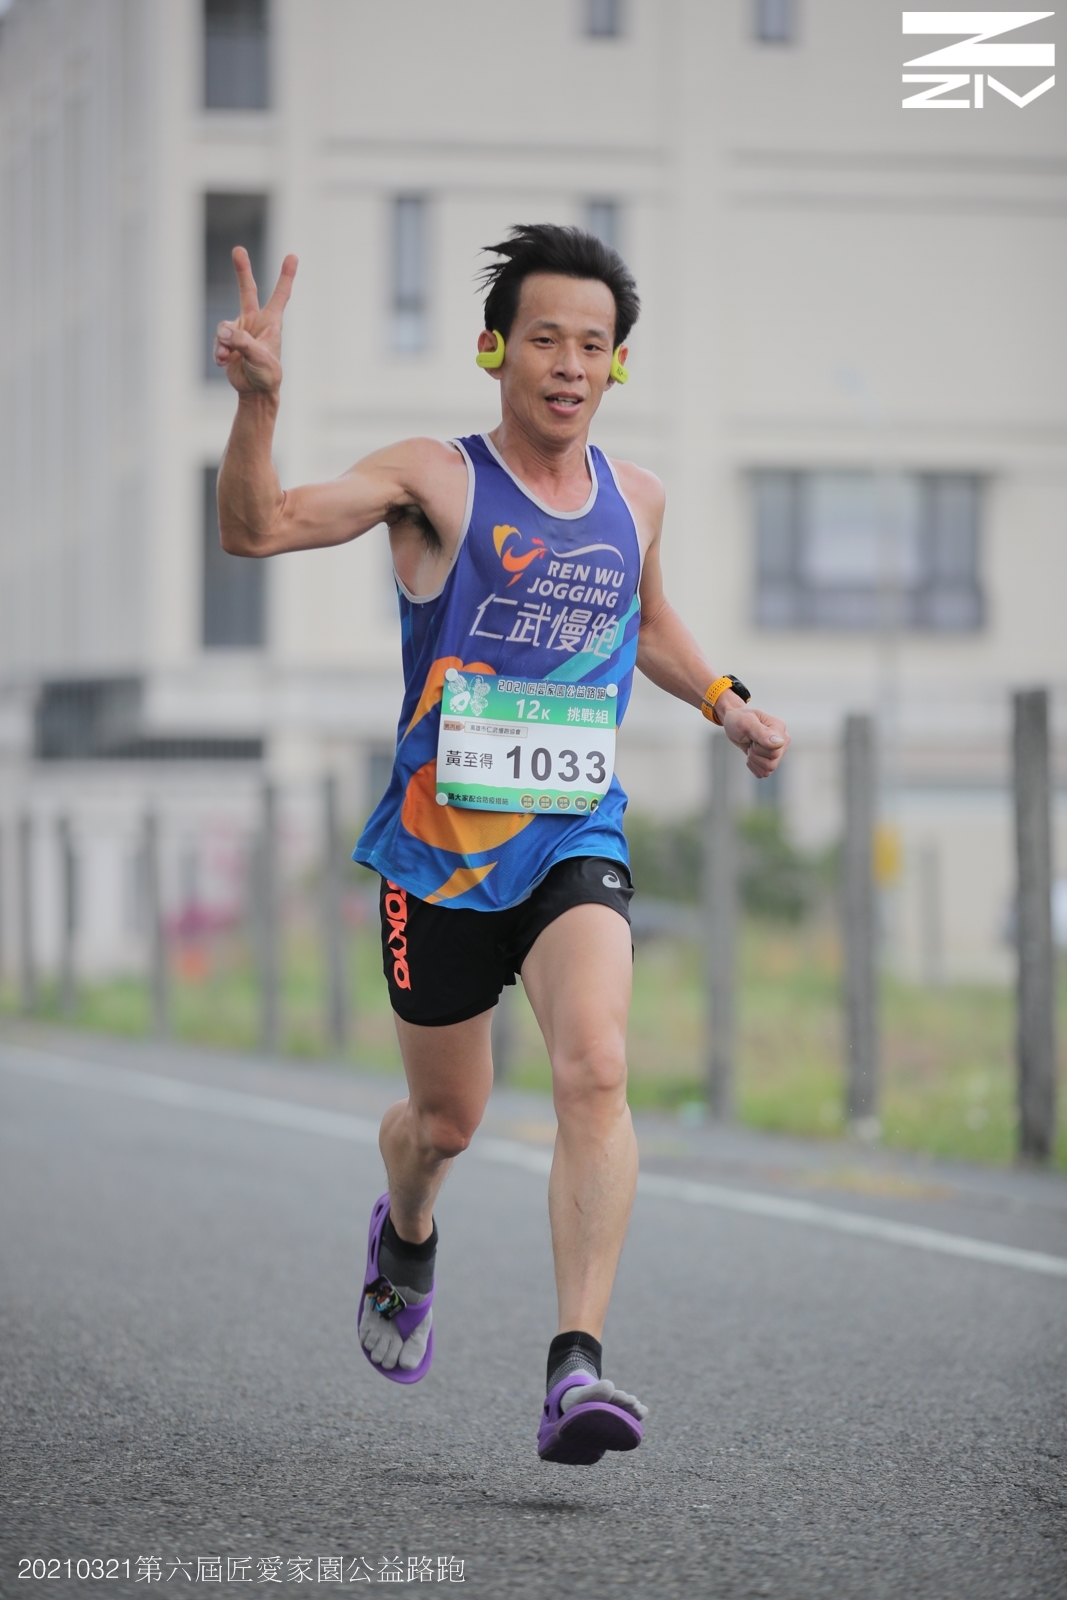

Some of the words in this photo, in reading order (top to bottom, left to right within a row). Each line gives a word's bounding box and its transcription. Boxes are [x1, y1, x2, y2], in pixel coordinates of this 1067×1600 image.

[547, 560, 591, 582] REN
[594, 567, 625, 588] WU
[527, 577, 620, 608] JOGGING
[469, 593, 620, 659] 仁武慢跑
[497, 679, 607, 701] 2021匠愛家園公益路跑
[566, 706, 609, 724] 挑戰組
[470, 724, 521, 736] 高雄市仁武慢跑協會
[445, 749, 494, 770] 黃至得
[506, 745, 607, 784] 1033
